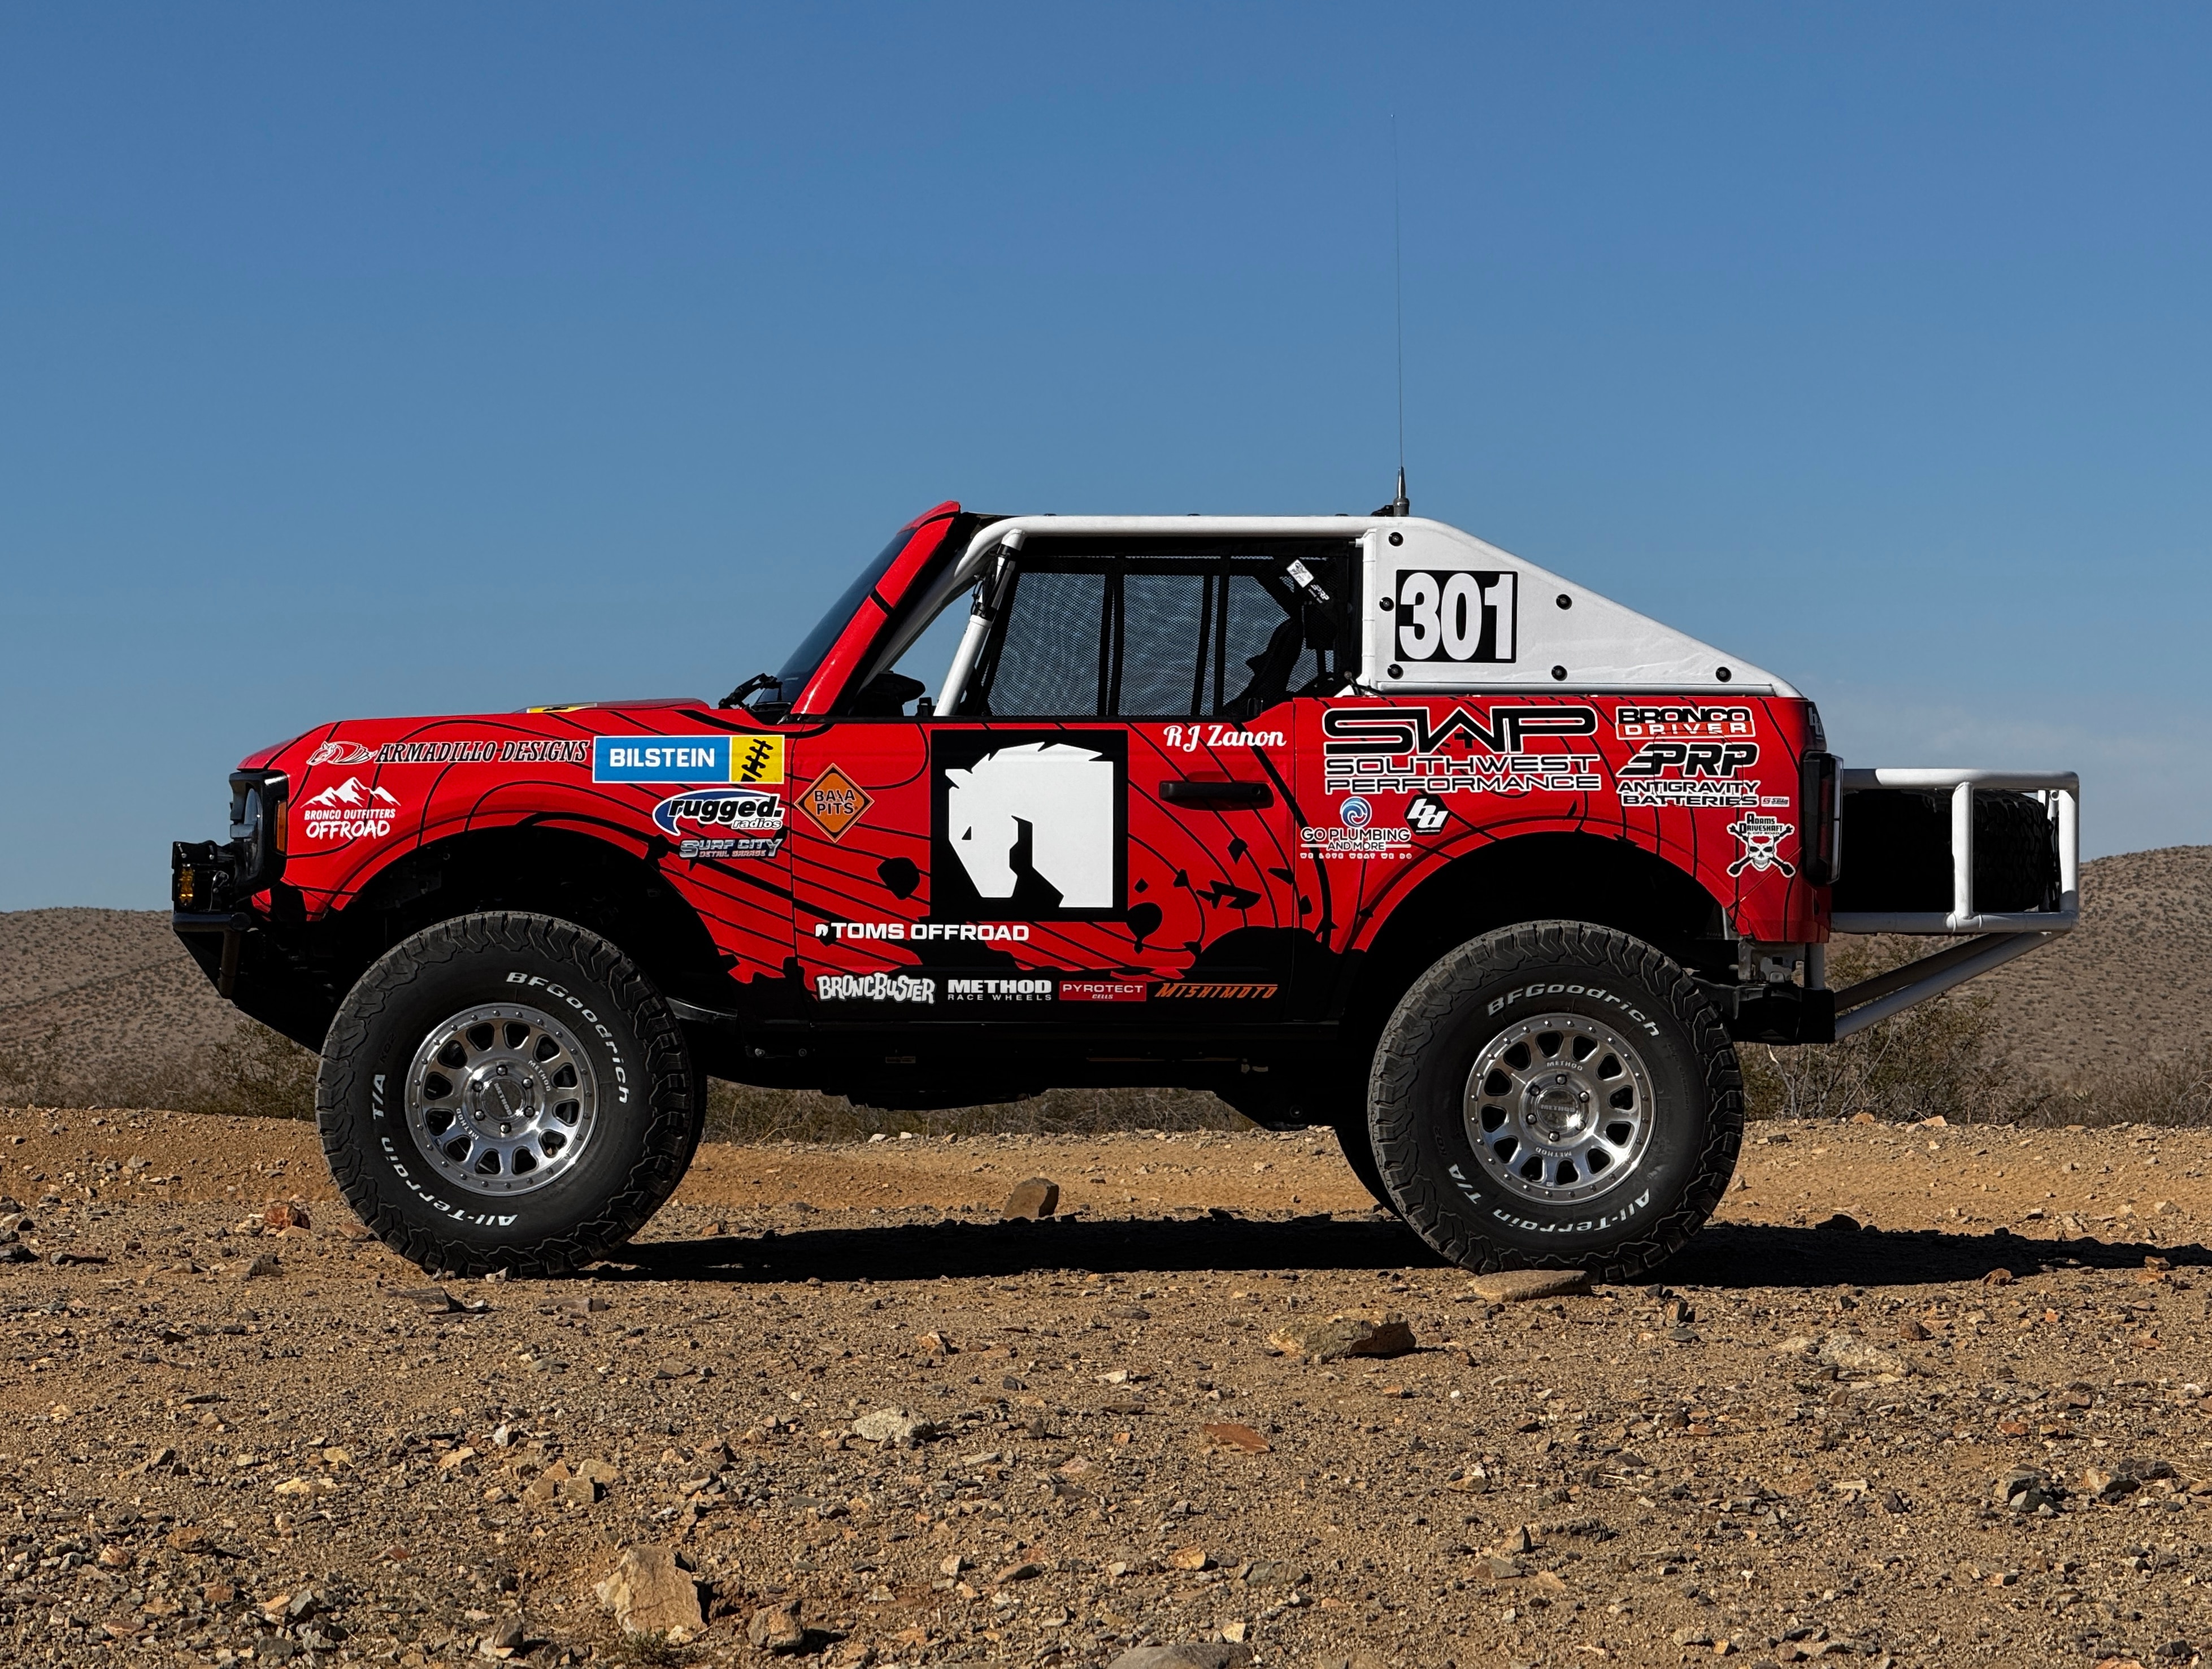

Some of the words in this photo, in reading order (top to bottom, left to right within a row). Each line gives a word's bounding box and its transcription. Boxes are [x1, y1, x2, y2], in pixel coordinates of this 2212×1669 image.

[1398, 572, 1513, 660] 301
[1617, 707, 1752, 724] BRONCO
[1207, 725, 1287, 746] Zanon
[1323, 706, 1597, 755] SWP
[1624, 722, 1747, 735] DRIVER
[374, 741, 497, 763] ARMADILLO
[498, 740, 590, 763] DESIGNS
[610, 748, 715, 767] BILSTEIN
[1616, 743, 1759, 776] PRP
[1325, 755, 1600, 776] SOUTHWEST
[1326, 775, 1601, 794] PERFORMANCE
[1618, 781, 1759, 793] ANTIGRAVITY
[817, 802, 854, 815] PITS
[1623, 795, 1758, 805] BATTERIES
[305, 809, 342, 820] BRONCO
[344, 808, 396, 819] OUTFITTERS
[1747, 814, 1775, 824] ADAMS
[306, 820, 390, 840] OFFROAD
[733, 819, 782, 829] radios
[1739, 823, 1783, 833] DRIVESHAFT
[1301, 828, 1327, 841] GO
[1329, 828, 1411, 841] PLUMBING
[679, 840, 735, 858] SURF
[737, 838, 783, 857] CITY
[1327, 842, 1351, 851] AND
[1353, 842, 1385, 851] MORE
[831, 923, 904, 939] TOMS
[911, 924, 1029, 941] OFFROAD
[948, 980, 1051, 993] METHOD
[1062, 984, 1144, 993] PYROTECT
[1154, 983, 1278, 998] MISHIMOTO
[1487, 983, 1661, 1037] BFGoodrich
[506, 972, 628, 1103] BFGoodrich
[1547, 1060, 1583, 1071] METHOD
[528, 1060, 551, 1092] METHOD
[372, 1074, 386, 1119] T/A
[494, 1083, 512, 1116] METHOD
[1541, 1104, 1576, 1112] METHOD
[457, 1107, 479, 1140] METHOD
[1535, 1146, 1572, 1157] METHOD
[381, 1137, 518, 1226] All-Terrain
[1449, 1164, 1481, 1204] T/A
[1493, 1188, 1650, 1233] All-Terrain
